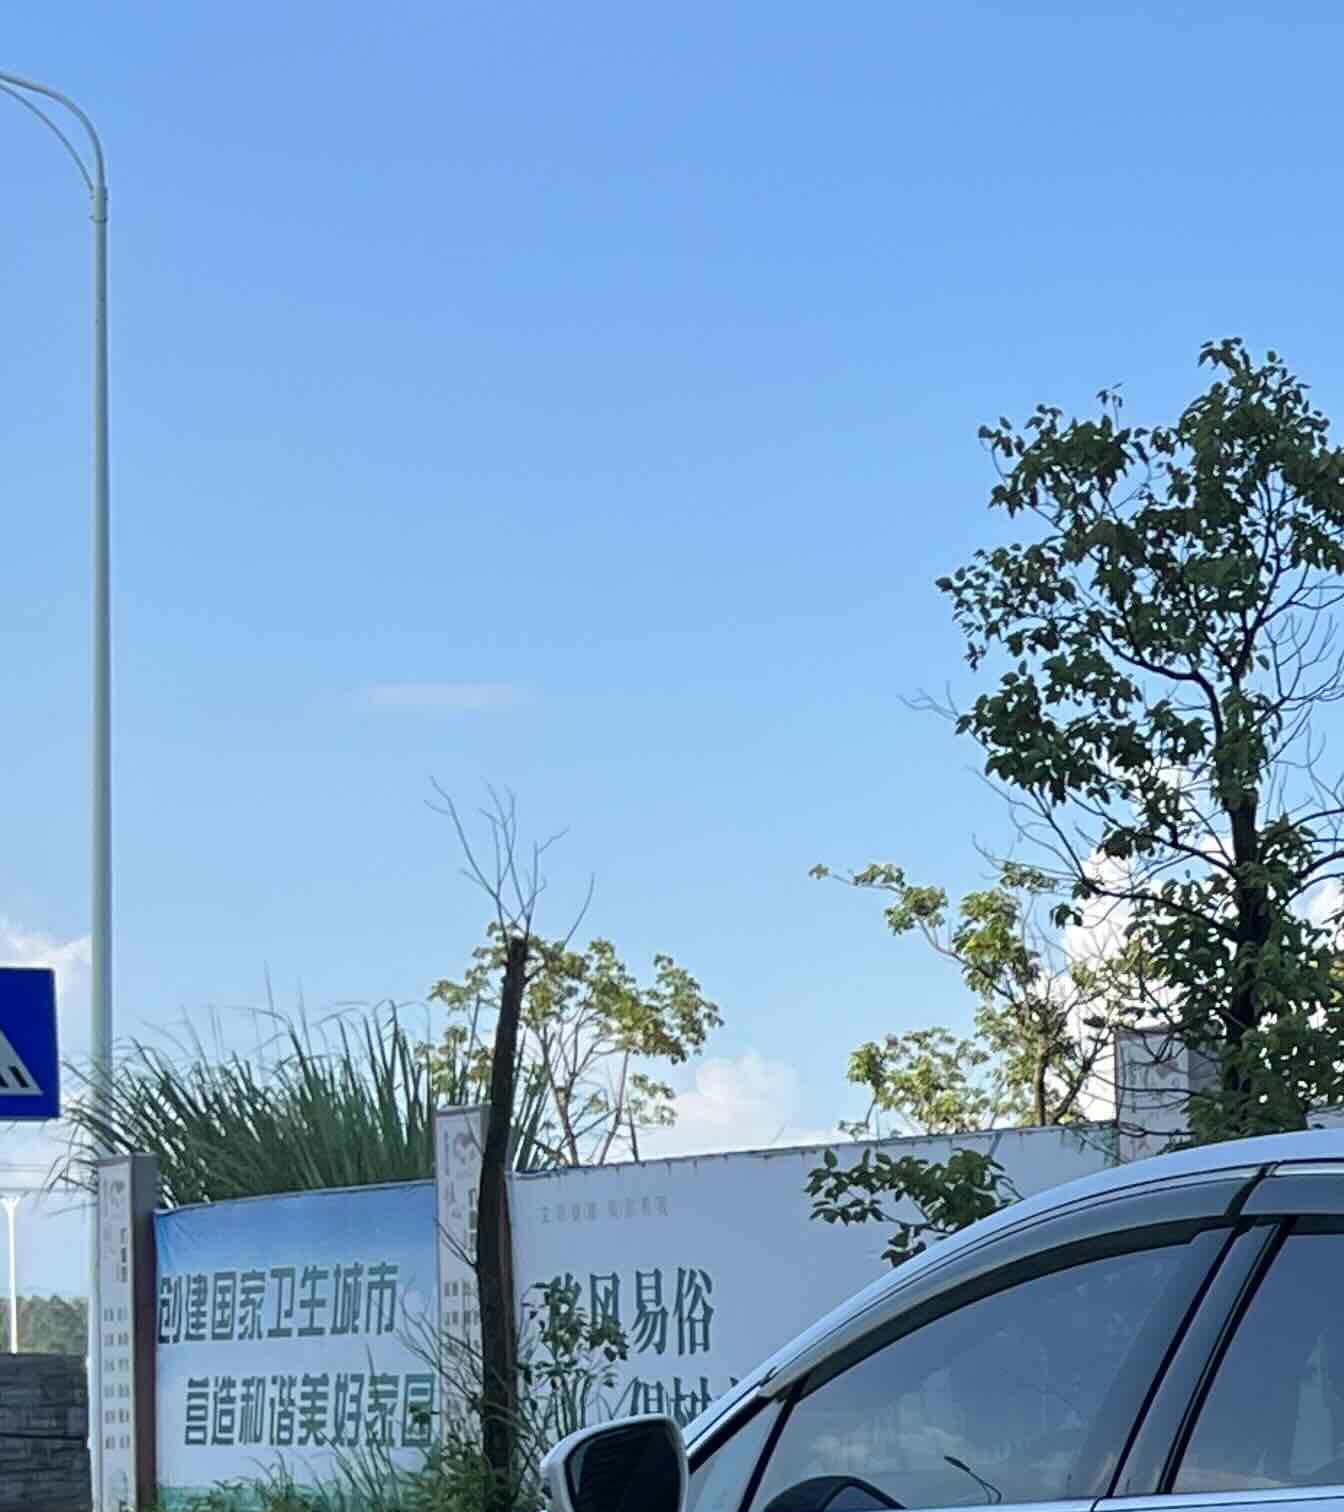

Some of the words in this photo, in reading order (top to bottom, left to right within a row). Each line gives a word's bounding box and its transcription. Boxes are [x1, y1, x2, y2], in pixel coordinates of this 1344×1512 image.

[157, 1261, 399, 1345] 创建国家卫生城市
[184, 1372, 437, 1449] 营造和谐美好家园
